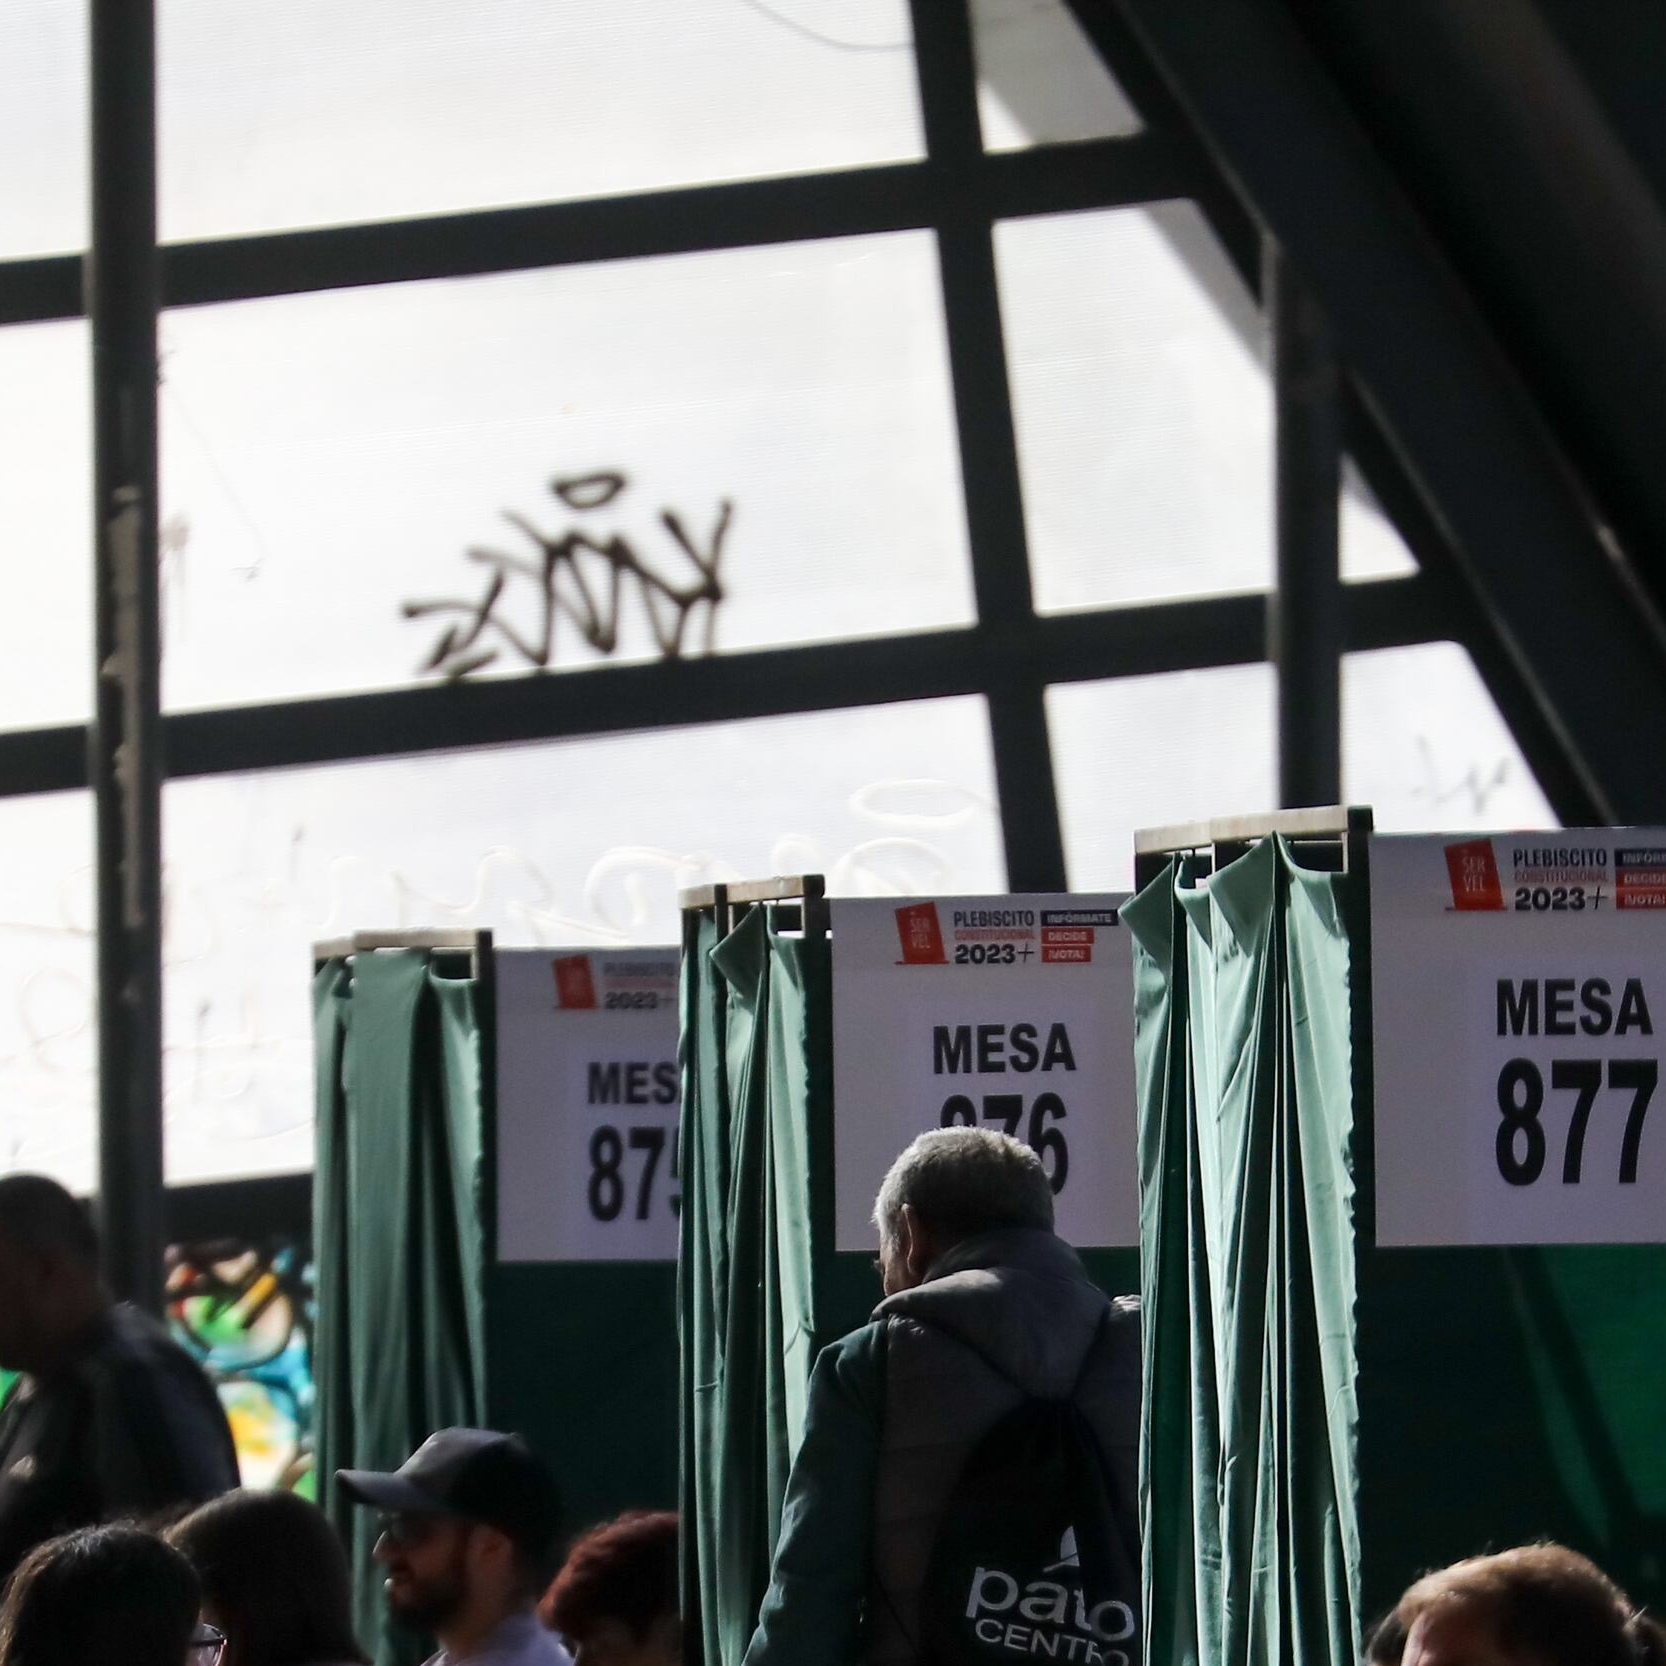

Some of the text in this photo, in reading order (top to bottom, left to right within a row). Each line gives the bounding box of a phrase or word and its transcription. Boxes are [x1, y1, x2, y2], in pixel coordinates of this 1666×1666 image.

[1513, 849, 1607, 867] PLEBISCITO
[953, 911, 1035, 928] PLEBISCITO
[1048, 931, 1087, 941] DECIDE
[1496, 977, 1654, 1037] MESA
[933, 1022, 1077, 1074] MESA
[588, 1061, 681, 1105] MES
[1495, 1057, 1659, 1187] 877
